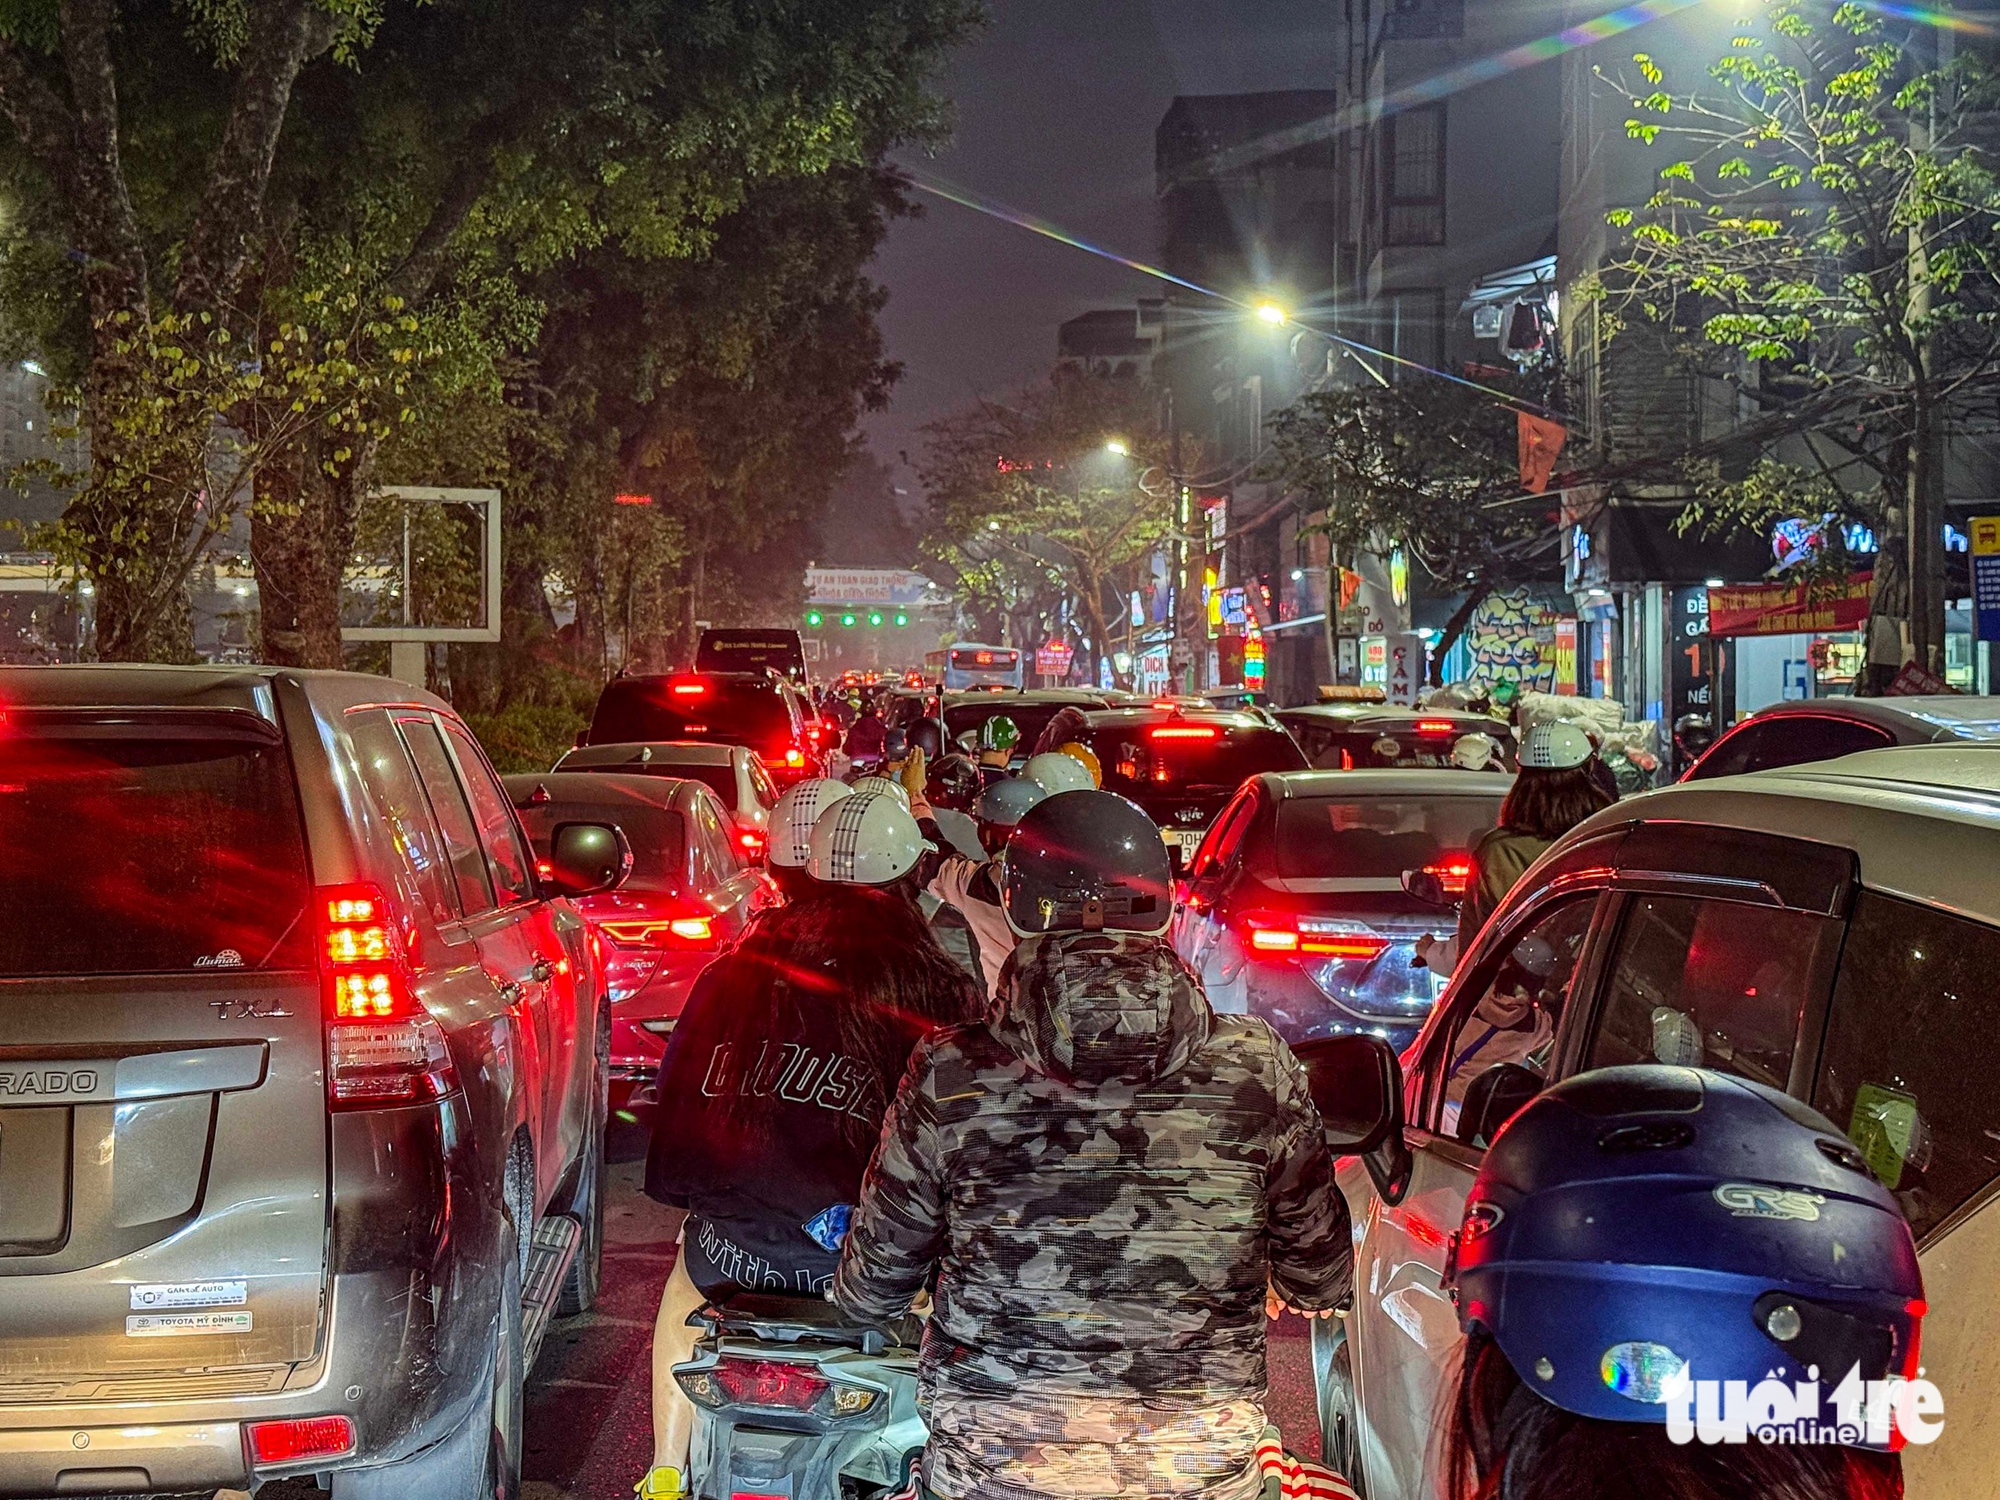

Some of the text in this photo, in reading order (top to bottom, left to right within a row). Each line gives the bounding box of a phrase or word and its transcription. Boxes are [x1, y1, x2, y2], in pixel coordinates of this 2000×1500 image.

[698, 1219, 788, 1291] with
[201, 1285, 224, 1293] AUTO
[160, 1317, 194, 1327] TOYOTA
